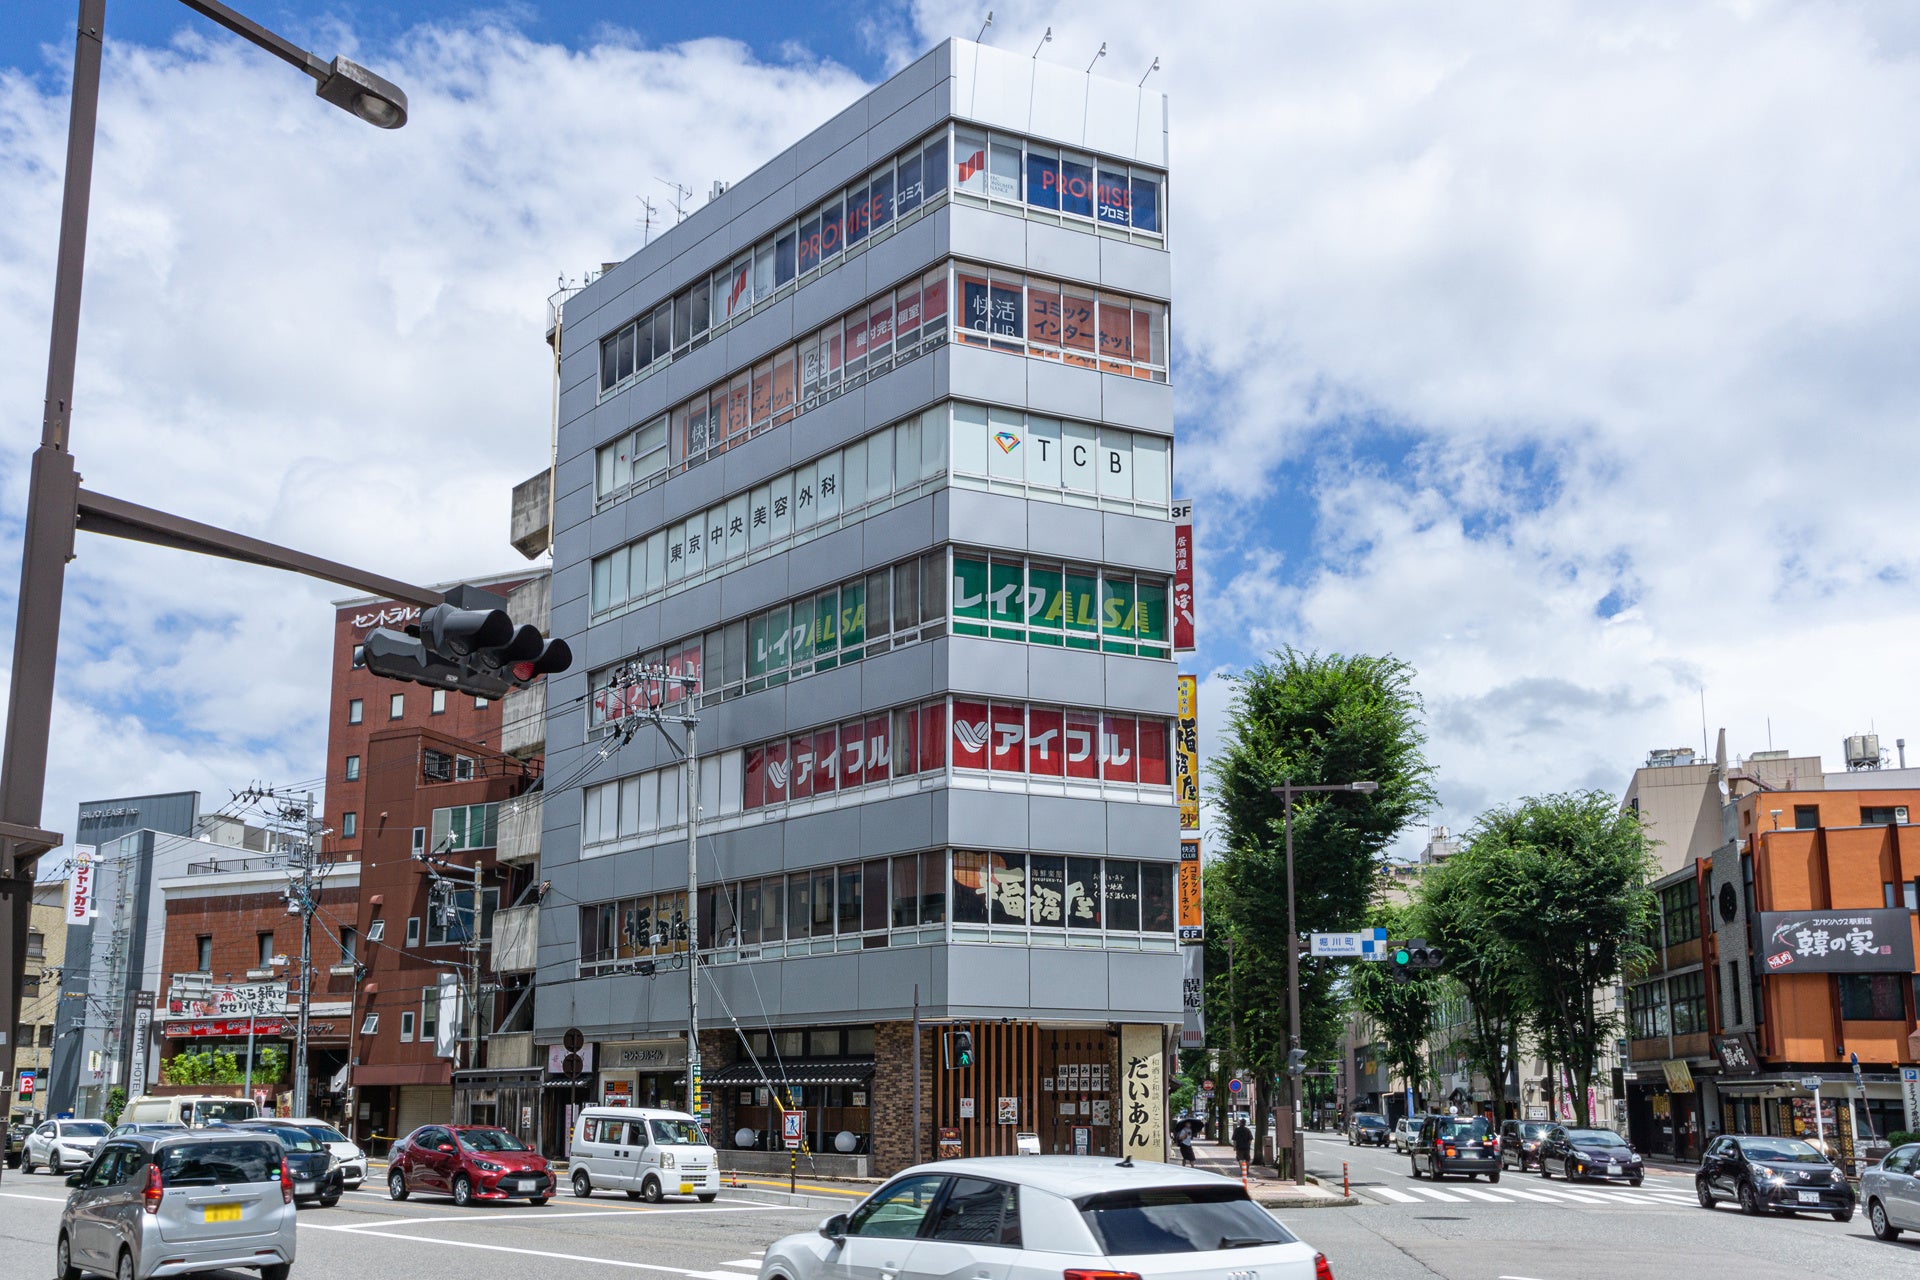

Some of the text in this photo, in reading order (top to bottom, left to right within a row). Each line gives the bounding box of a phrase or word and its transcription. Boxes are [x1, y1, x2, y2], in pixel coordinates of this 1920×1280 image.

[1042, 170, 1134, 210] PROMISE
[800, 194, 882, 262] PROMISE
[1099, 205, 1133, 223] プロミス
[972, 294, 1016, 322] 快活
[1033, 299, 1091, 323] コミック
[1033, 322, 1136, 350] インターネット
[1037, 439, 1122, 473] TCB
[670, 474, 836, 563] 東京中央美容外科
[1171, 507, 1191, 518] 3F
[1176, 537, 1188, 571] 居酒屋
[995, 722, 1130, 766] アイフル
[797, 735, 890, 785] アイフル
[1182, 845, 1196, 853] 快活
[1181, 867, 1189, 920] インターネット
[1190, 866, 1198, 896] コミック
[1183, 930, 1198, 938] 6F
[1319, 937, 1354, 946] 堀川町
[1795, 927, 1879, 957] 韓の家
[220, 985, 284, 1002] 赤から鍋と
[136, 1012, 147, 1057] CENTRAL
[624, 1049, 664, 1060] セントラルビル
[132, 1062, 142, 1095] HOTEL
[1127, 1055, 1149, 1147] だいあん
